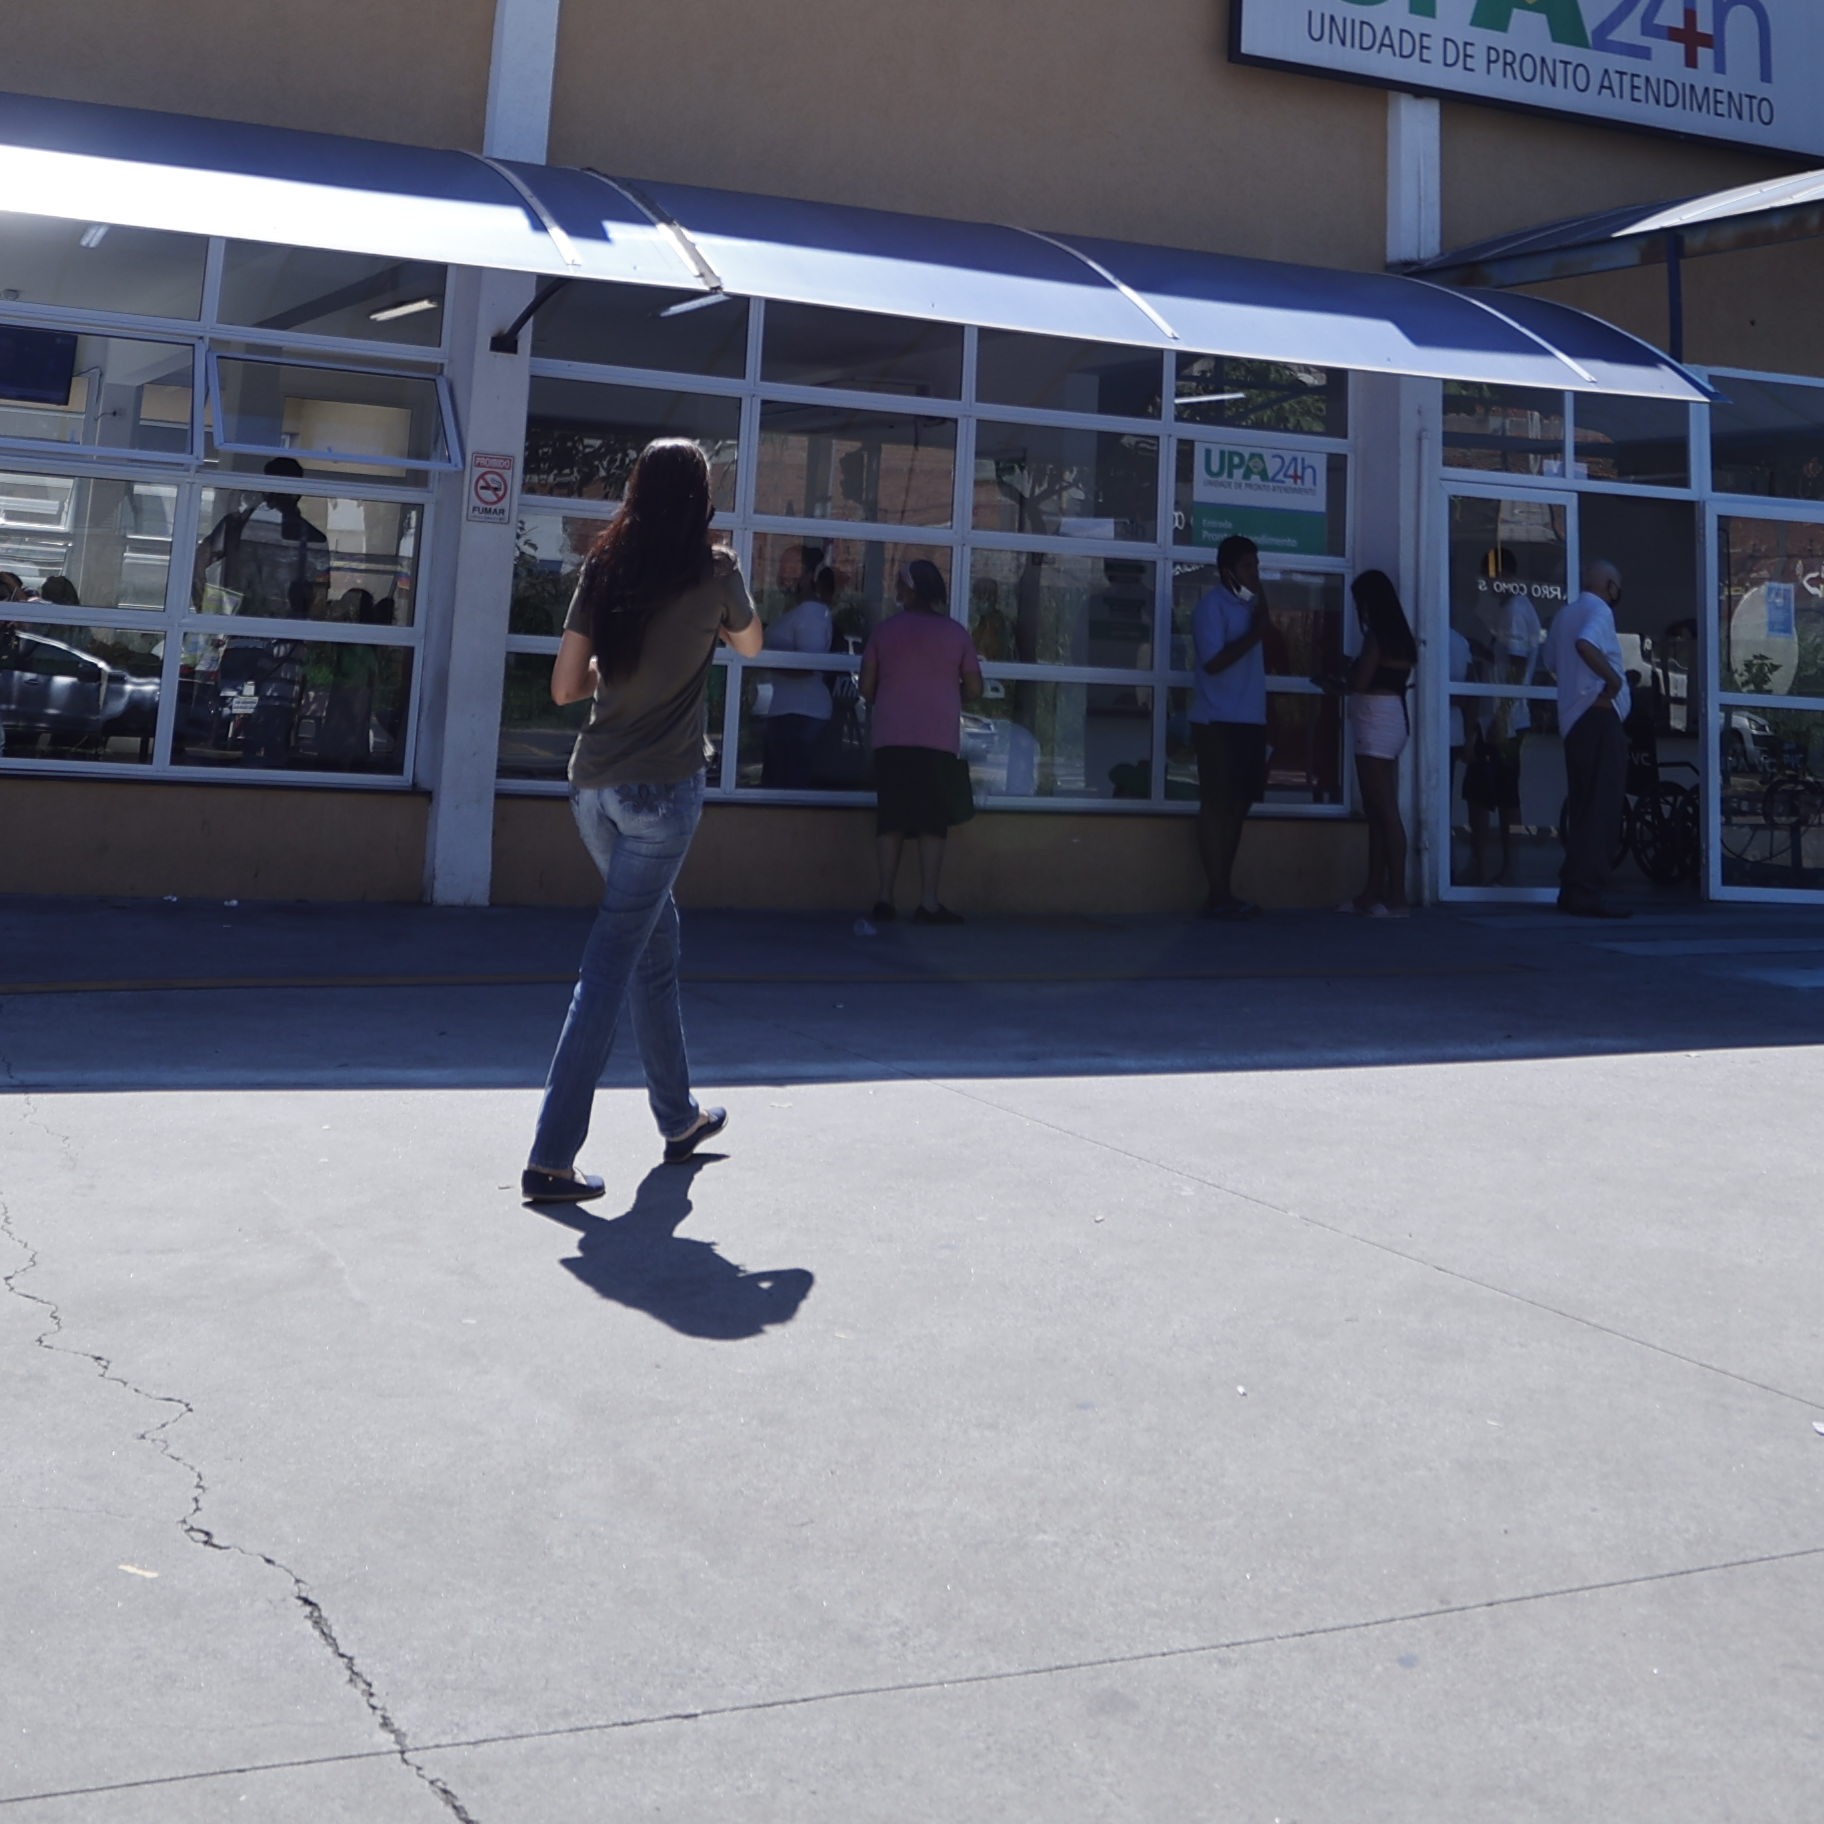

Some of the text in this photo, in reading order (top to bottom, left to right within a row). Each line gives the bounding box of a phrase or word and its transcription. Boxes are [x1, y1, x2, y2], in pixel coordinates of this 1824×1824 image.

[1306, 9, 1775, 127] UNIDADE DE PRONTO ATENDIMENTO
[1204, 448, 1317, 487] UPA 24h
[472, 506, 505, 516] FUMAR
